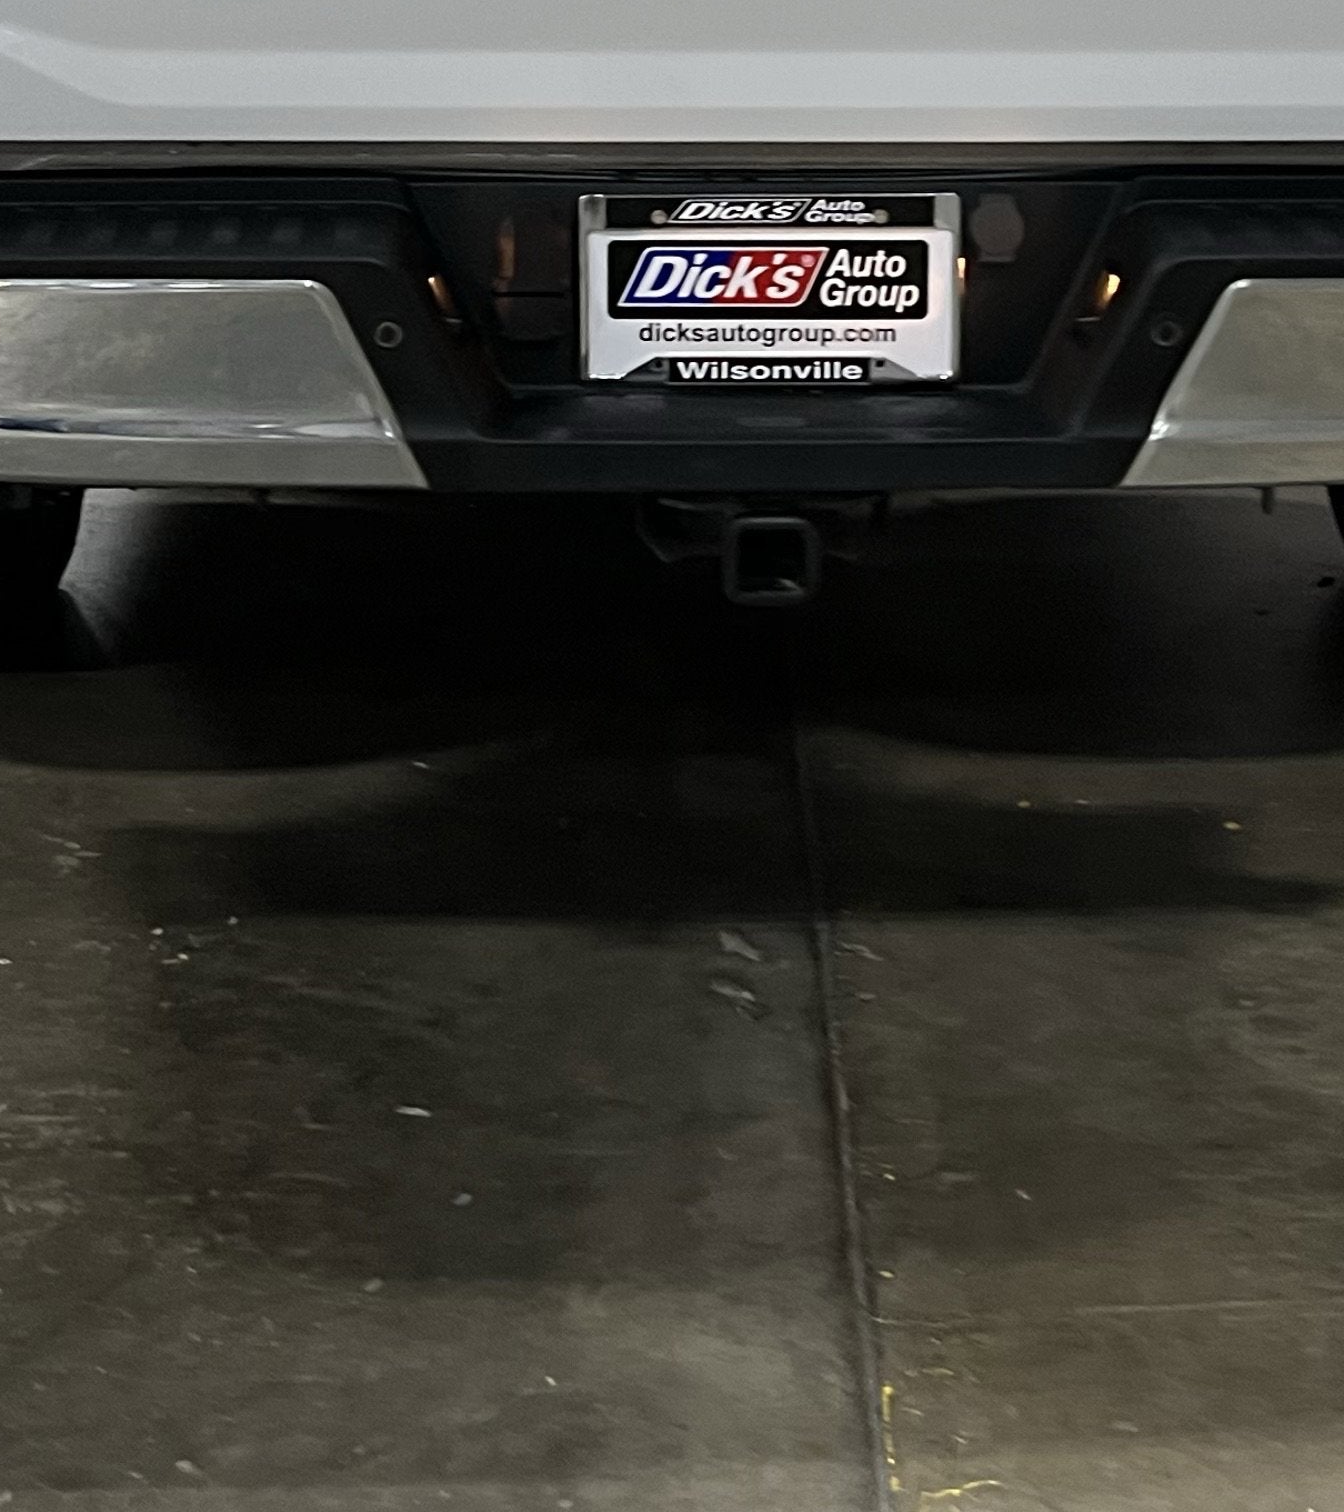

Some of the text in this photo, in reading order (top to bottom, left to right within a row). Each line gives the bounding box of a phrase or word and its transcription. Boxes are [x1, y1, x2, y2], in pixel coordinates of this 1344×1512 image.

[677, 201, 798, 221] Dick's
[811, 199, 866, 211] Auto
[826, 249, 907, 278] Auto
[633, 253, 805, 300] Dick's
[819, 279, 920, 313] Group
[638, 323, 897, 347] dicksautogroup.com
[676, 361, 864, 381] Wilsonville
